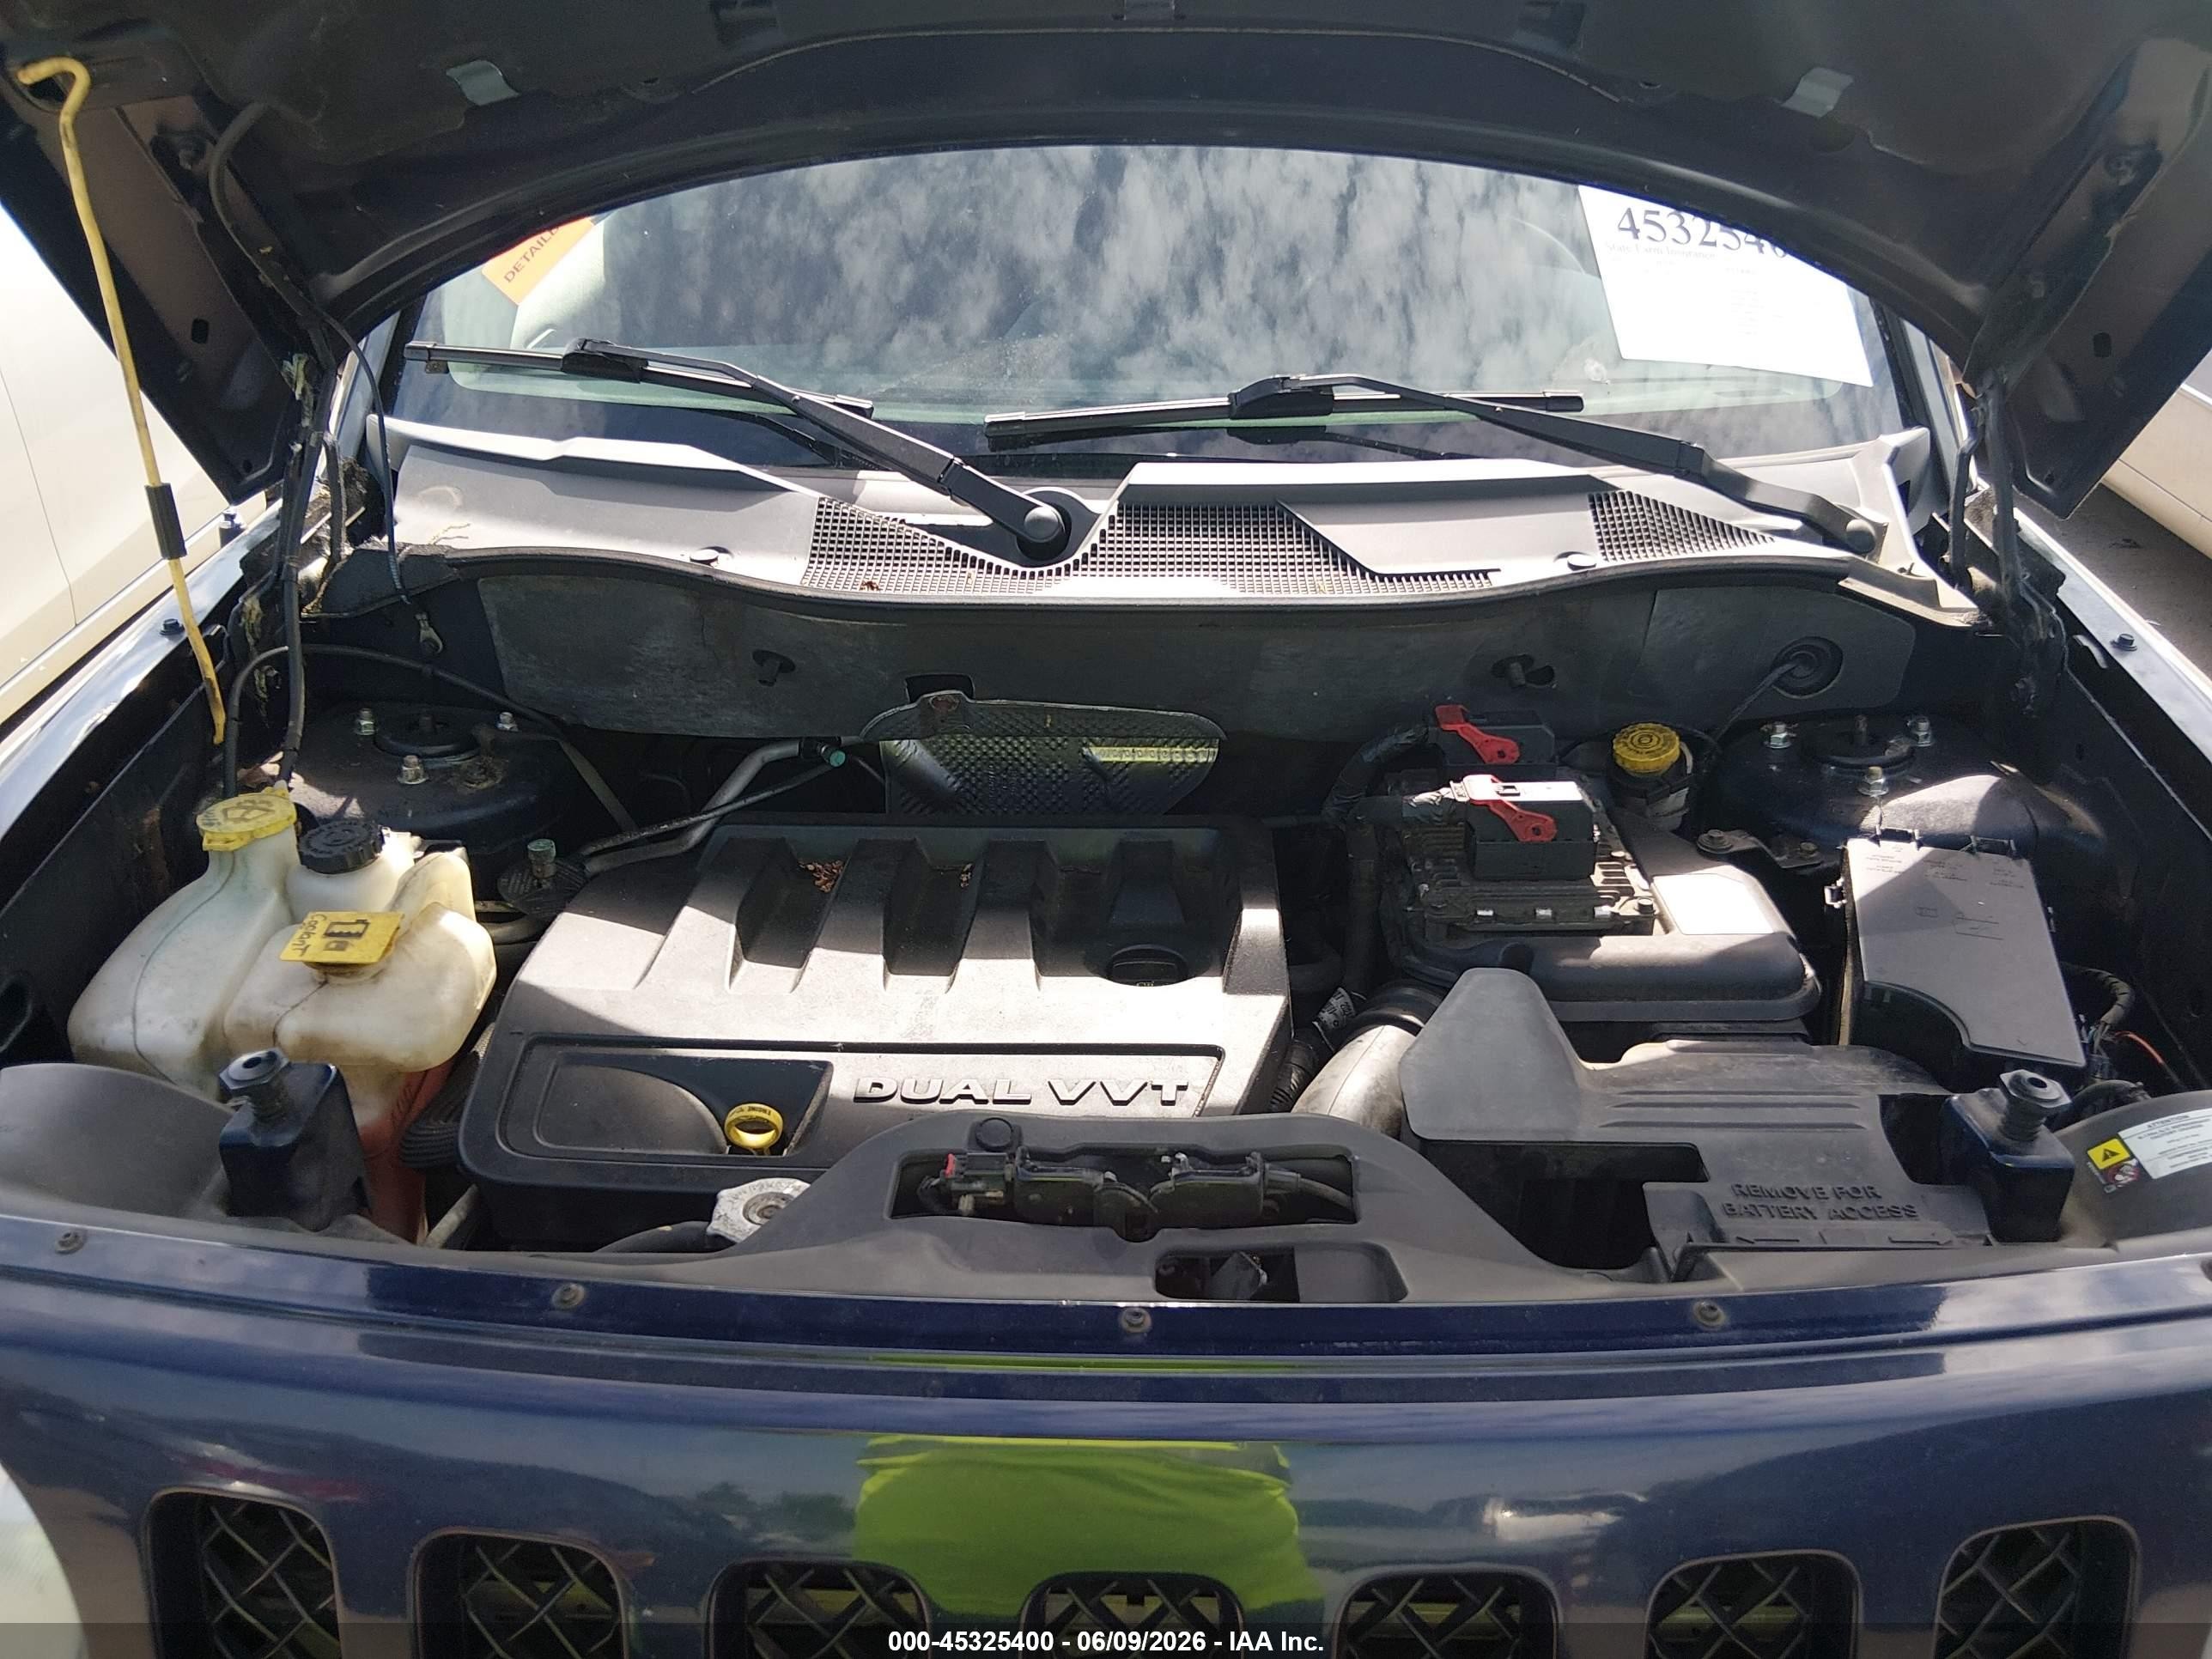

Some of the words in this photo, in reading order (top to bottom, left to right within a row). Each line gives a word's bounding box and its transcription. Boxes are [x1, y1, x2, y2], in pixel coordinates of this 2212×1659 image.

[854, 1078, 1032, 1105] DUAL
[1047, 1079, 1188, 1107] VVT
[1731, 1183, 1829, 1200] REMOVE
[1832, 1185, 1882, 1200] FOR
[1721, 1202, 1818, 1220] BATTERY
[1828, 1204, 1919, 1221] ACCESS
